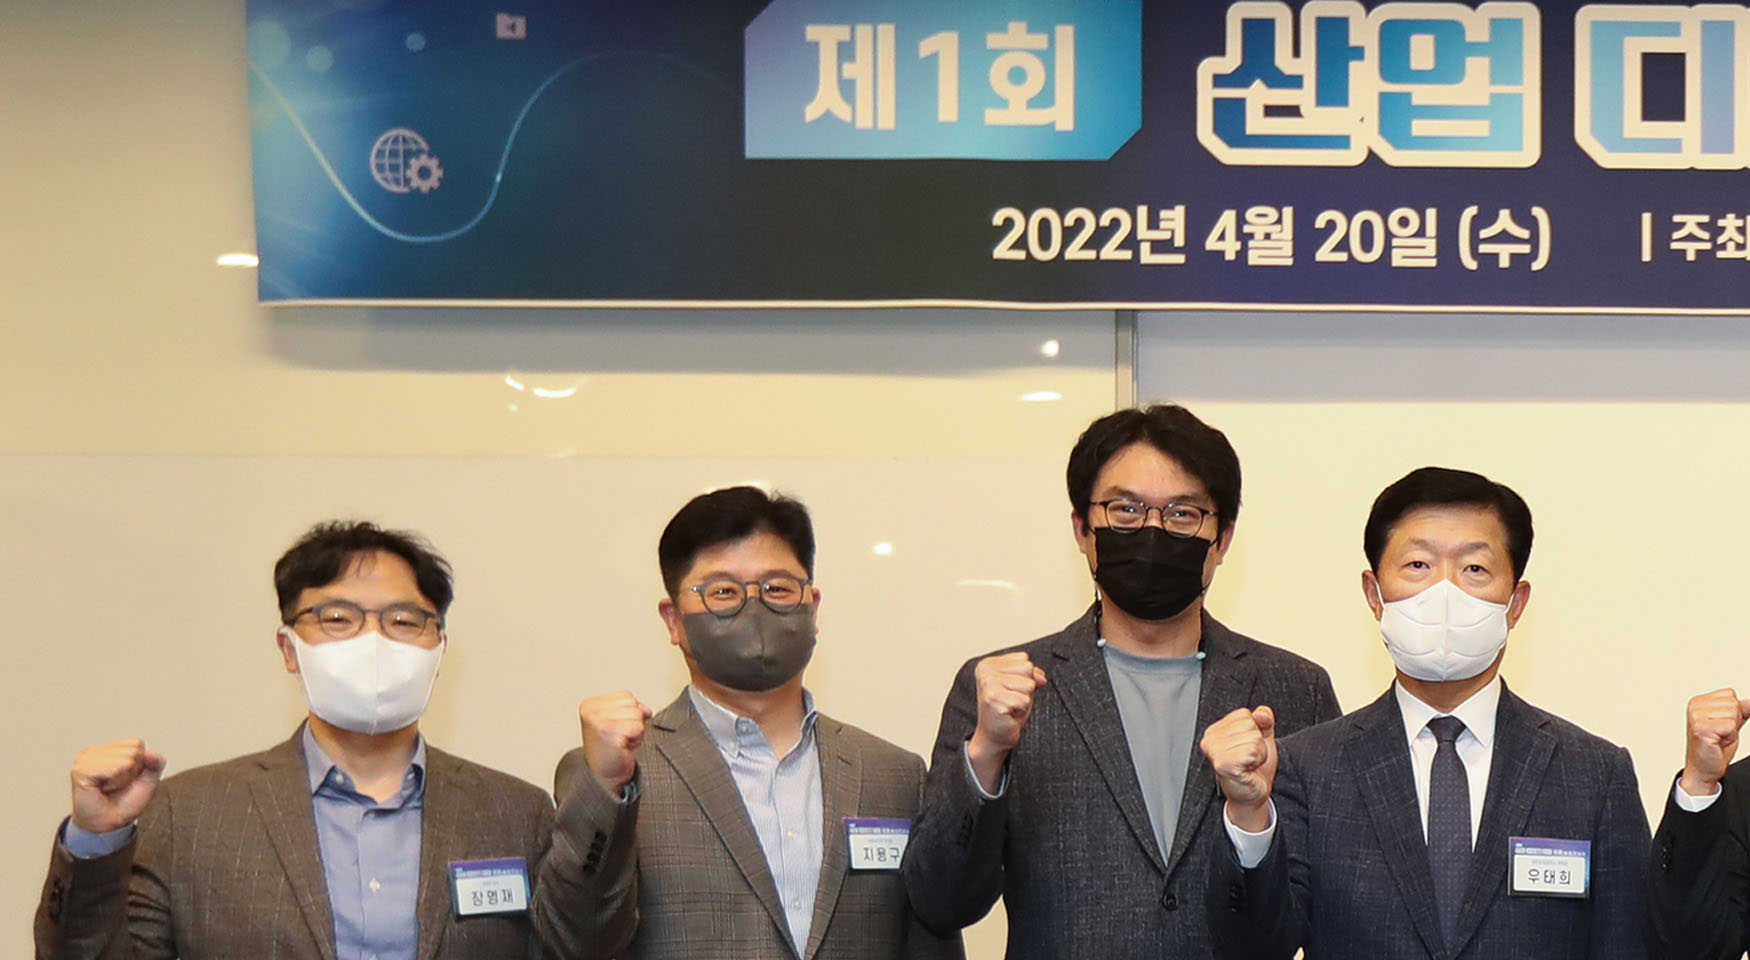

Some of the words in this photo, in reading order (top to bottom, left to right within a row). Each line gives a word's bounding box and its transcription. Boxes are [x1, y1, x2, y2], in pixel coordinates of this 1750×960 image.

[804, 22, 1075, 132] 제1회
[1197, 1, 1542, 167] 산업
[991, 205, 1187, 265] 2022년
[1205, 206, 1295, 266] 4월
[1314, 206, 1439, 268] 20일
[1457, 206, 1552, 271] (수)
[863, 847, 901, 863] 지용구
[1527, 868, 1571, 886] 우태희
